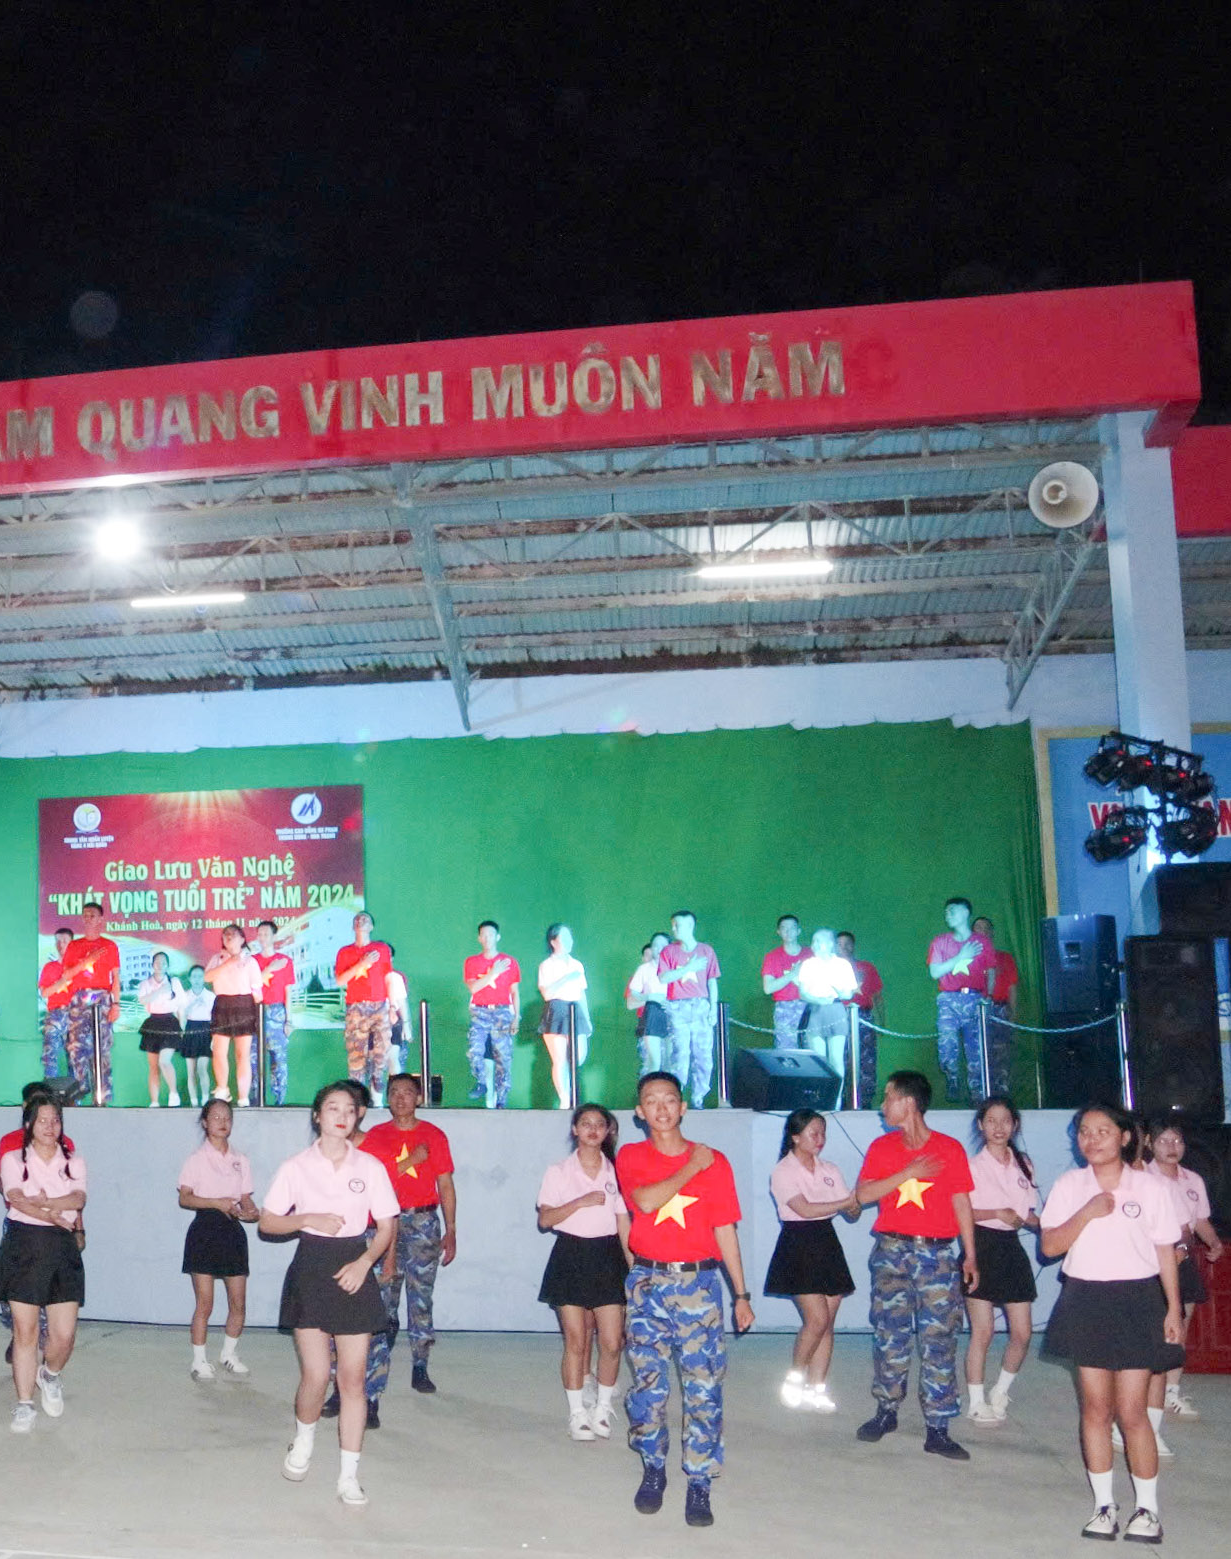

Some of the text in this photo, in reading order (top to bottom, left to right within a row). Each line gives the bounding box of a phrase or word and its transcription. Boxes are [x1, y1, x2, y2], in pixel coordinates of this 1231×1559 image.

[76, 385, 280, 462] QUANG
[299, 371, 444, 436] VINH
[471, 341, 662, 421] MUÔN
[690, 331, 845, 407] NĂM
[104, 852, 295, 882] Giao Lưu Văn Nghệ
[109, 890, 159, 918] VỌNG
[163, 879, 207, 912] TUỔI
[260, 880, 302, 909] NĂM
[307, 883, 355, 908] 2024
[191, 918, 203, 930] 12
